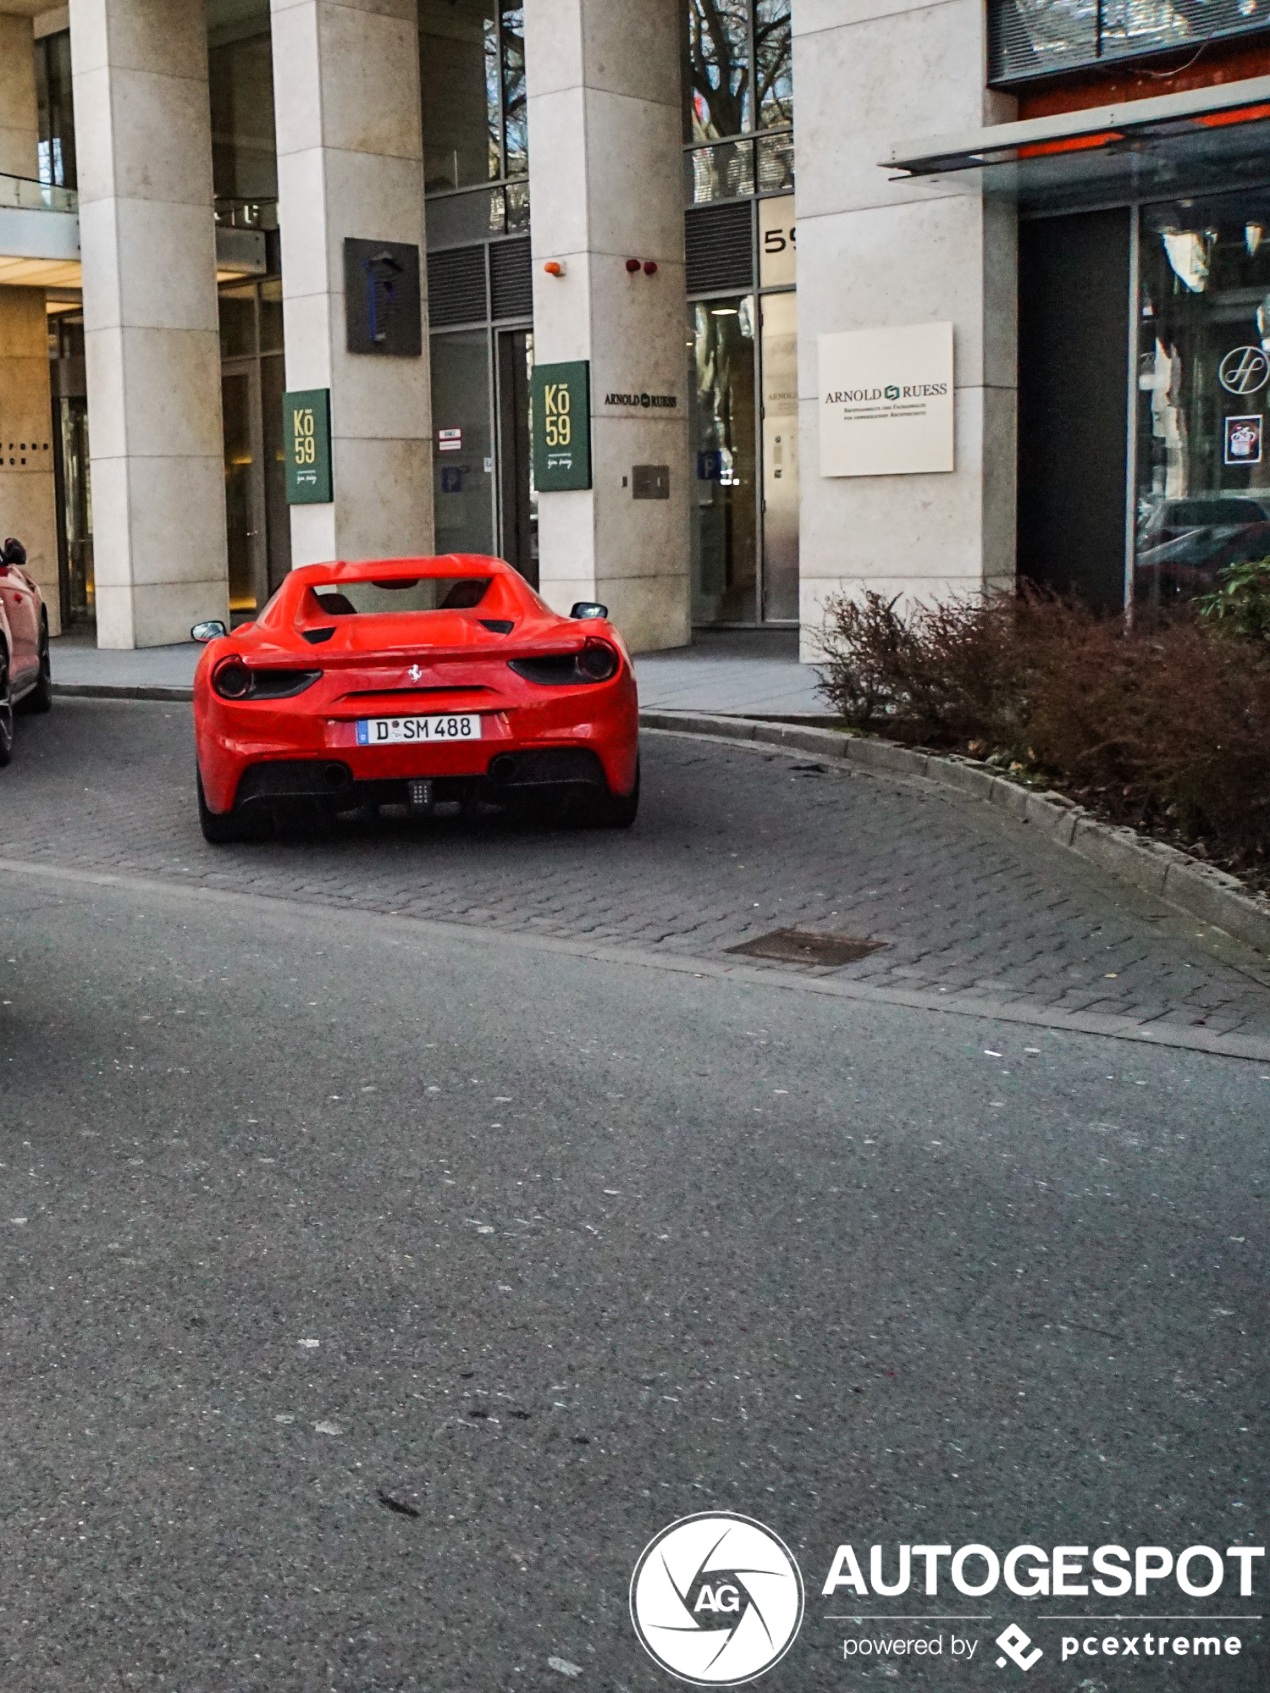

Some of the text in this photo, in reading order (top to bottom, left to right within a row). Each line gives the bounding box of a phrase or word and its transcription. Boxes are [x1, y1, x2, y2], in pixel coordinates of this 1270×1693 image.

[604, 393, 677, 408] ARNOLD RUESS
[825, 383, 948, 404] ARNOLD RUESS
[545, 415, 571, 446] 59
[294, 437, 316, 465] 59
[376, 717, 472, 740] D SM 488
